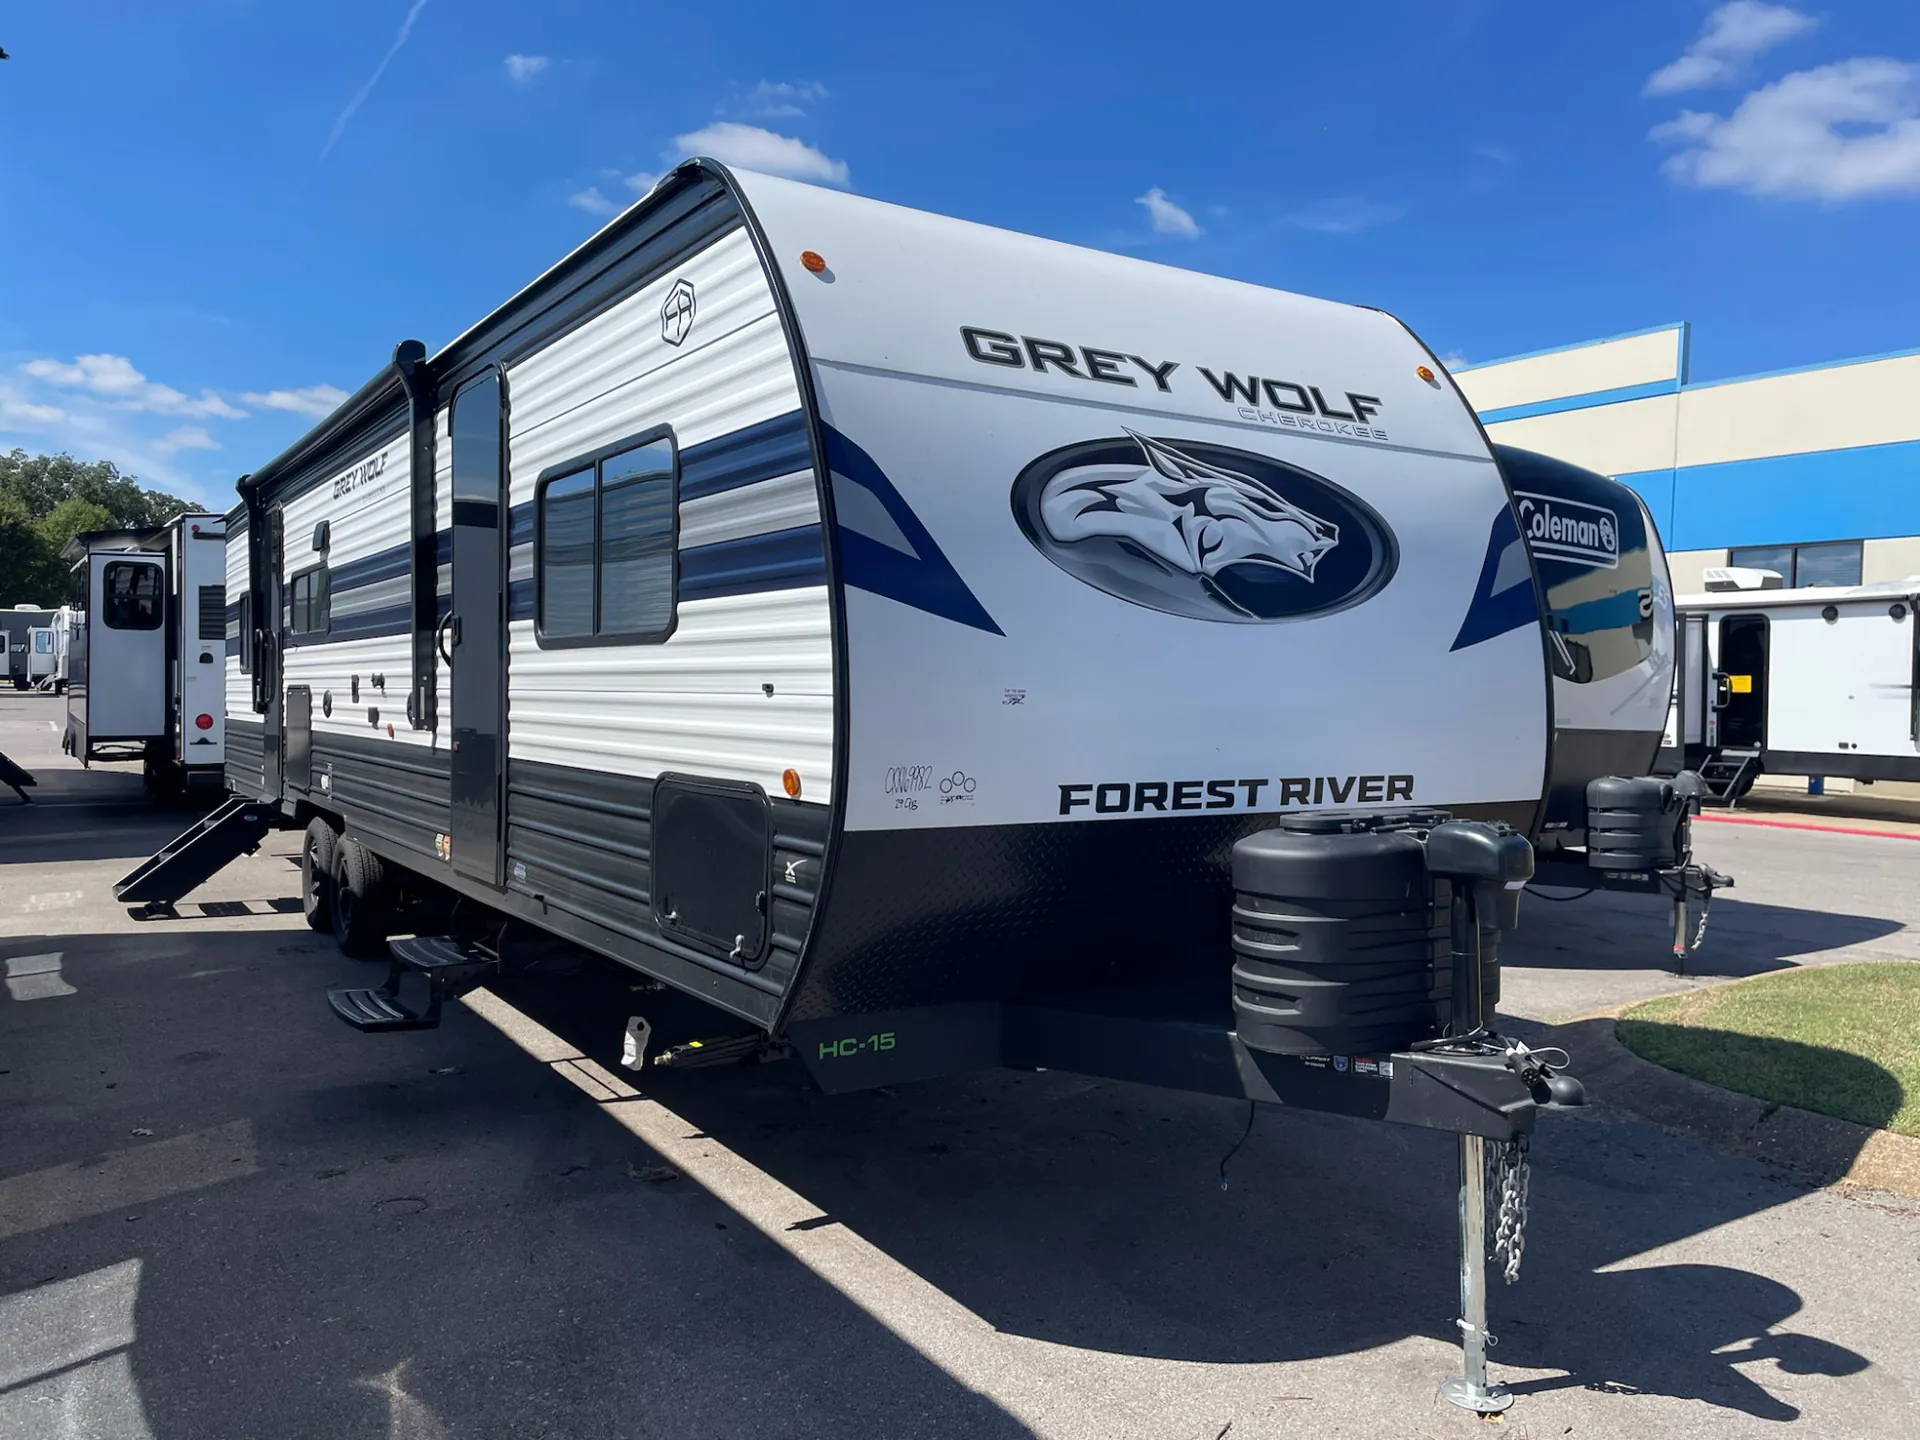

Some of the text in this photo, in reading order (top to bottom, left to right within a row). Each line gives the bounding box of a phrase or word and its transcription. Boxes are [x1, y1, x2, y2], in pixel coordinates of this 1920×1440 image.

[960, 325, 1383, 424] GREY WOLF
[1238, 407, 1388, 441] CHEROKEE
[333, 468, 358, 499] GREY
[360, 451, 388, 485] WOLF
[1519, 499, 1599, 548] Coleman
[1058, 774, 1414, 815] FOREST RIVER
[819, 1032, 896, 1060] HC-15
